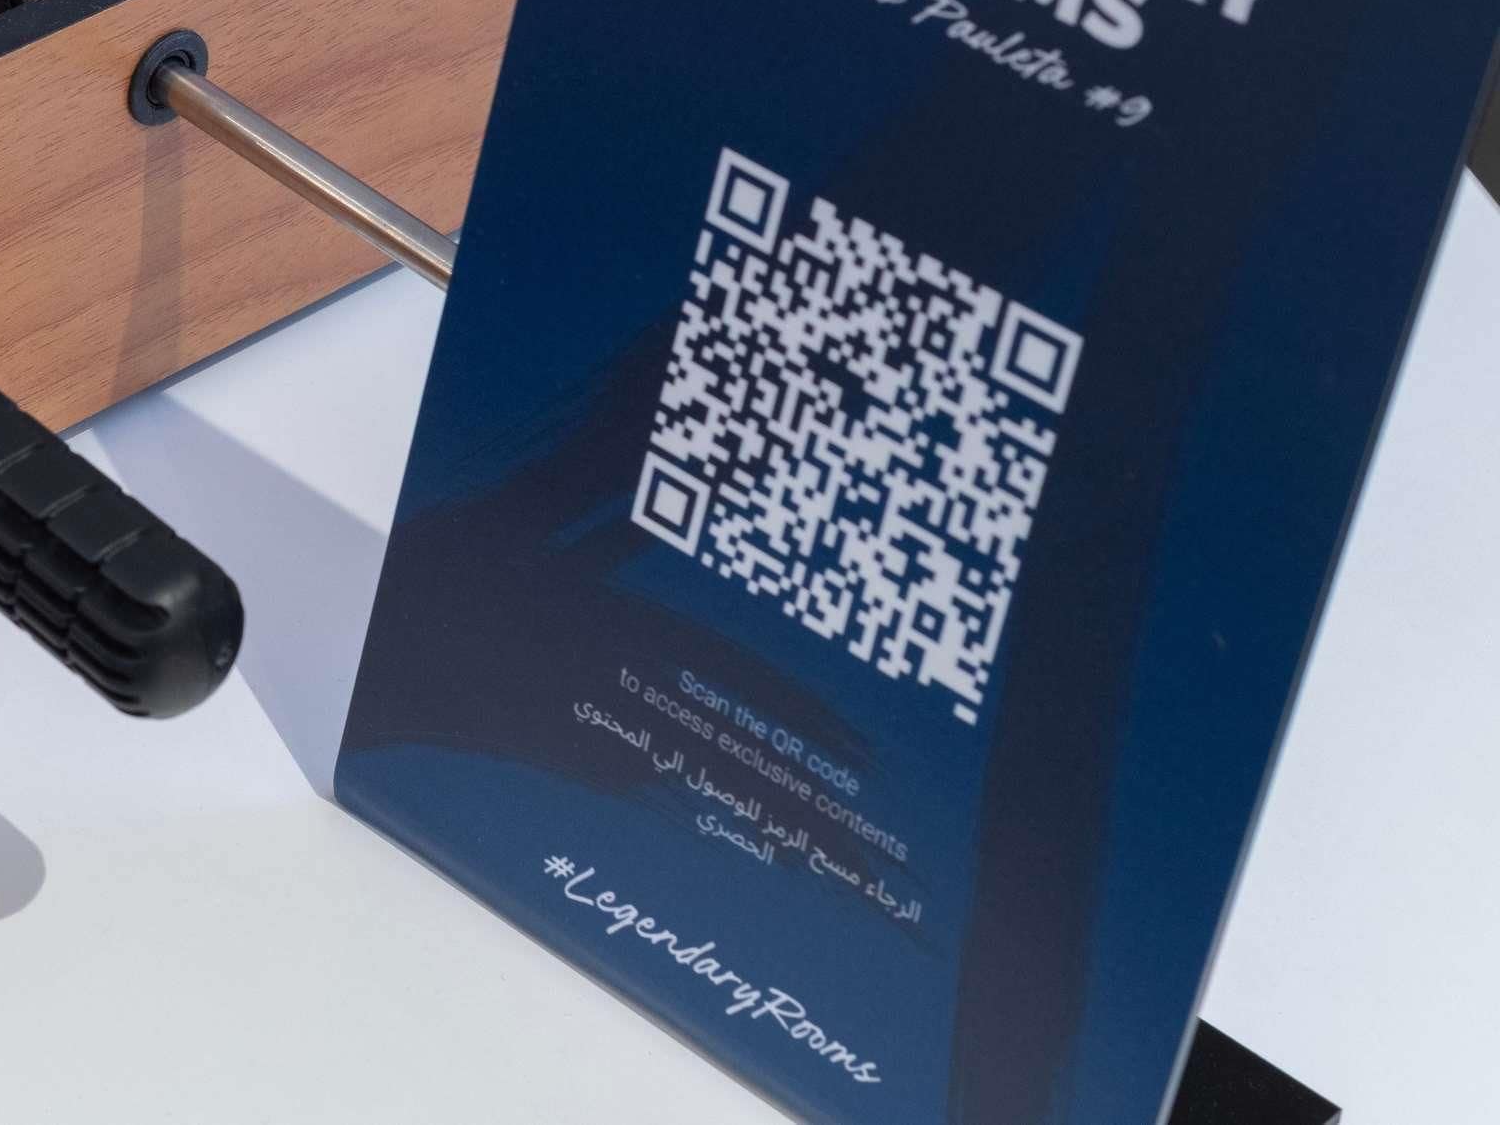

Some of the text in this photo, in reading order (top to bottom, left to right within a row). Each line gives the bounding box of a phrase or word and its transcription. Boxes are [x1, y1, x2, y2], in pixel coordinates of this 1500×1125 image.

[1084, 85, 1152, 126] #9
[679, 671, 860, 797] Scan the QR code
[619, 667, 908, 862] to access exclusive contents
[686, 768, 762, 821] للوصول
[696, 814, 775, 866] الحصري
[761, 814, 809, 852] الرمز
[808, 845, 861, 886] مسح
[865, 878, 922, 923] الرجاء
[544, 855, 882, 1084] #LegendaryRooms
